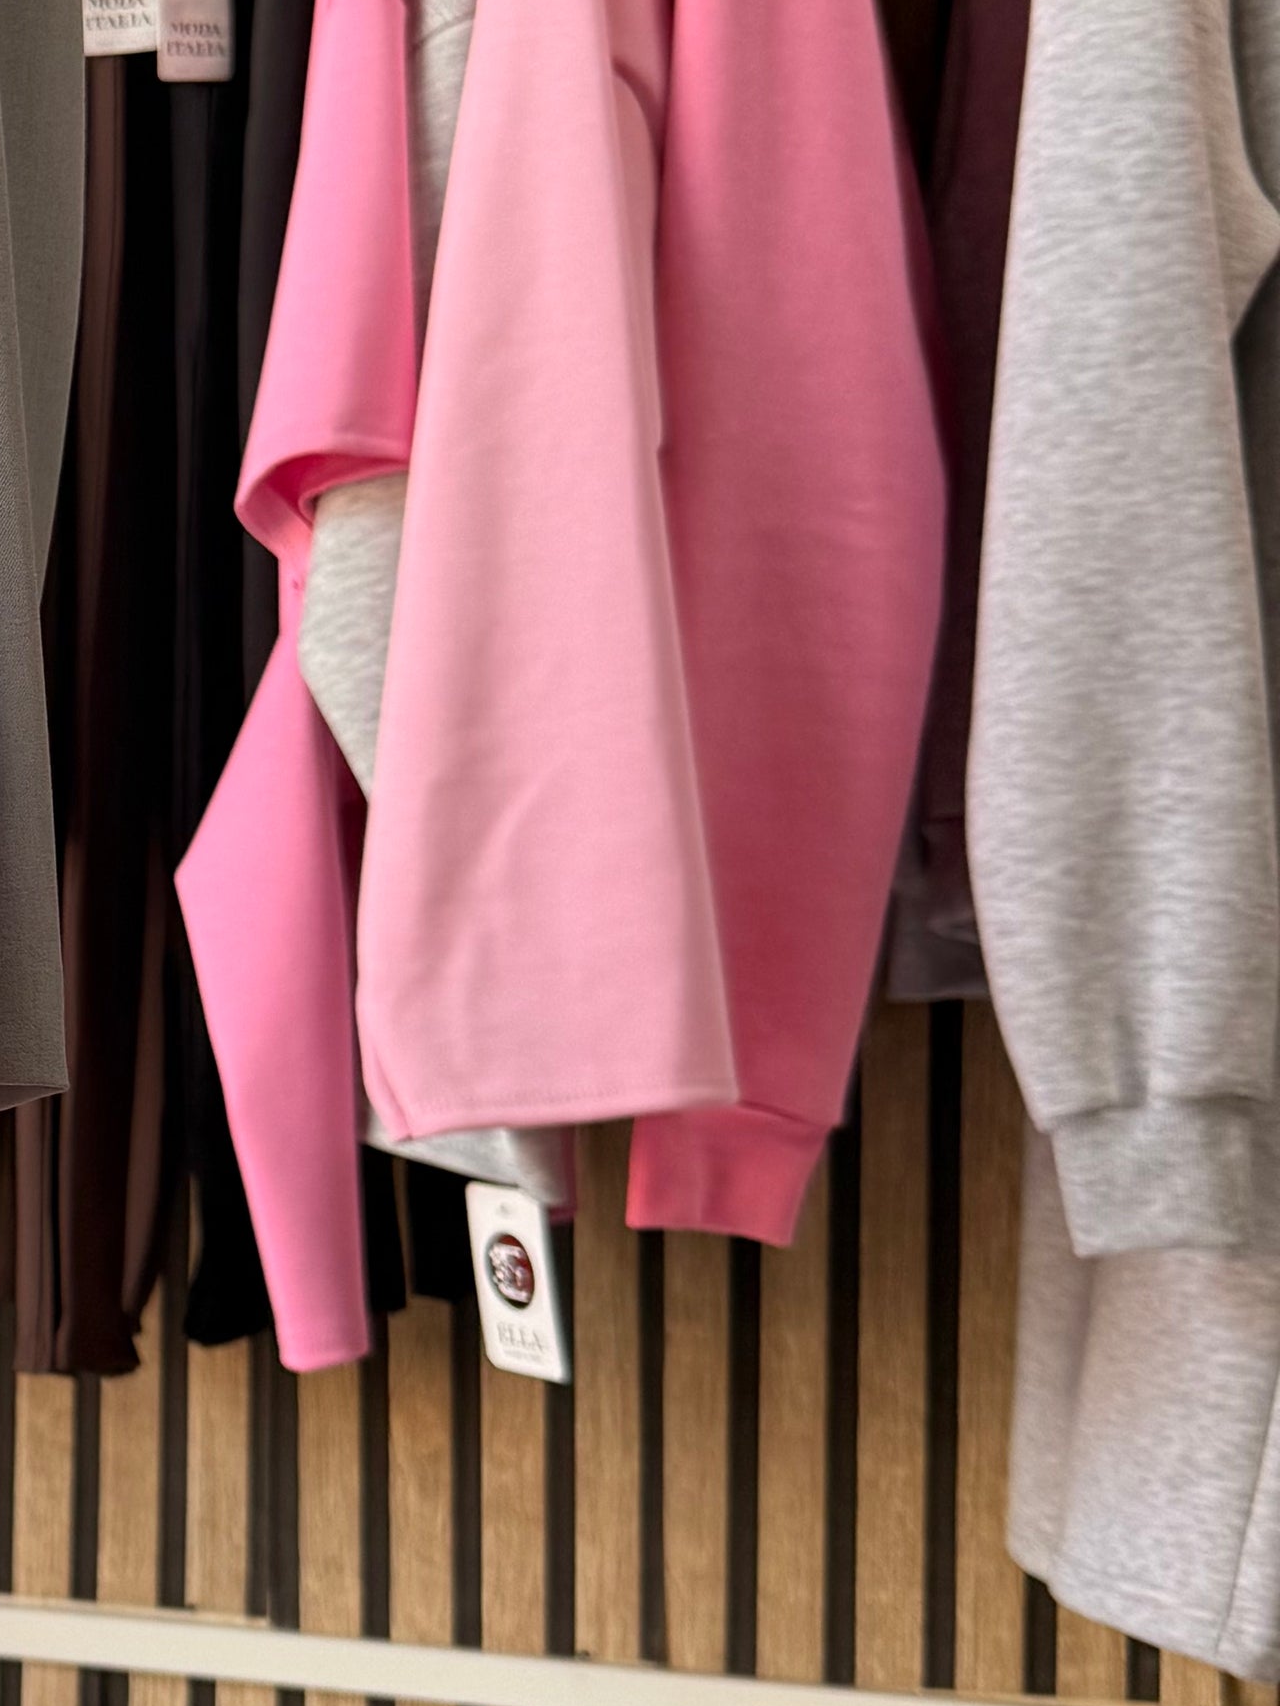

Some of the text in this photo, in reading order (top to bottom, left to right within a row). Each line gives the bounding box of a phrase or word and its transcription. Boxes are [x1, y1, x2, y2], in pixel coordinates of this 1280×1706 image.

[85, 12, 153, 30] ITALIA
[170, 22, 220, 37] MODA
[166, 41, 226, 57] ITALIA
